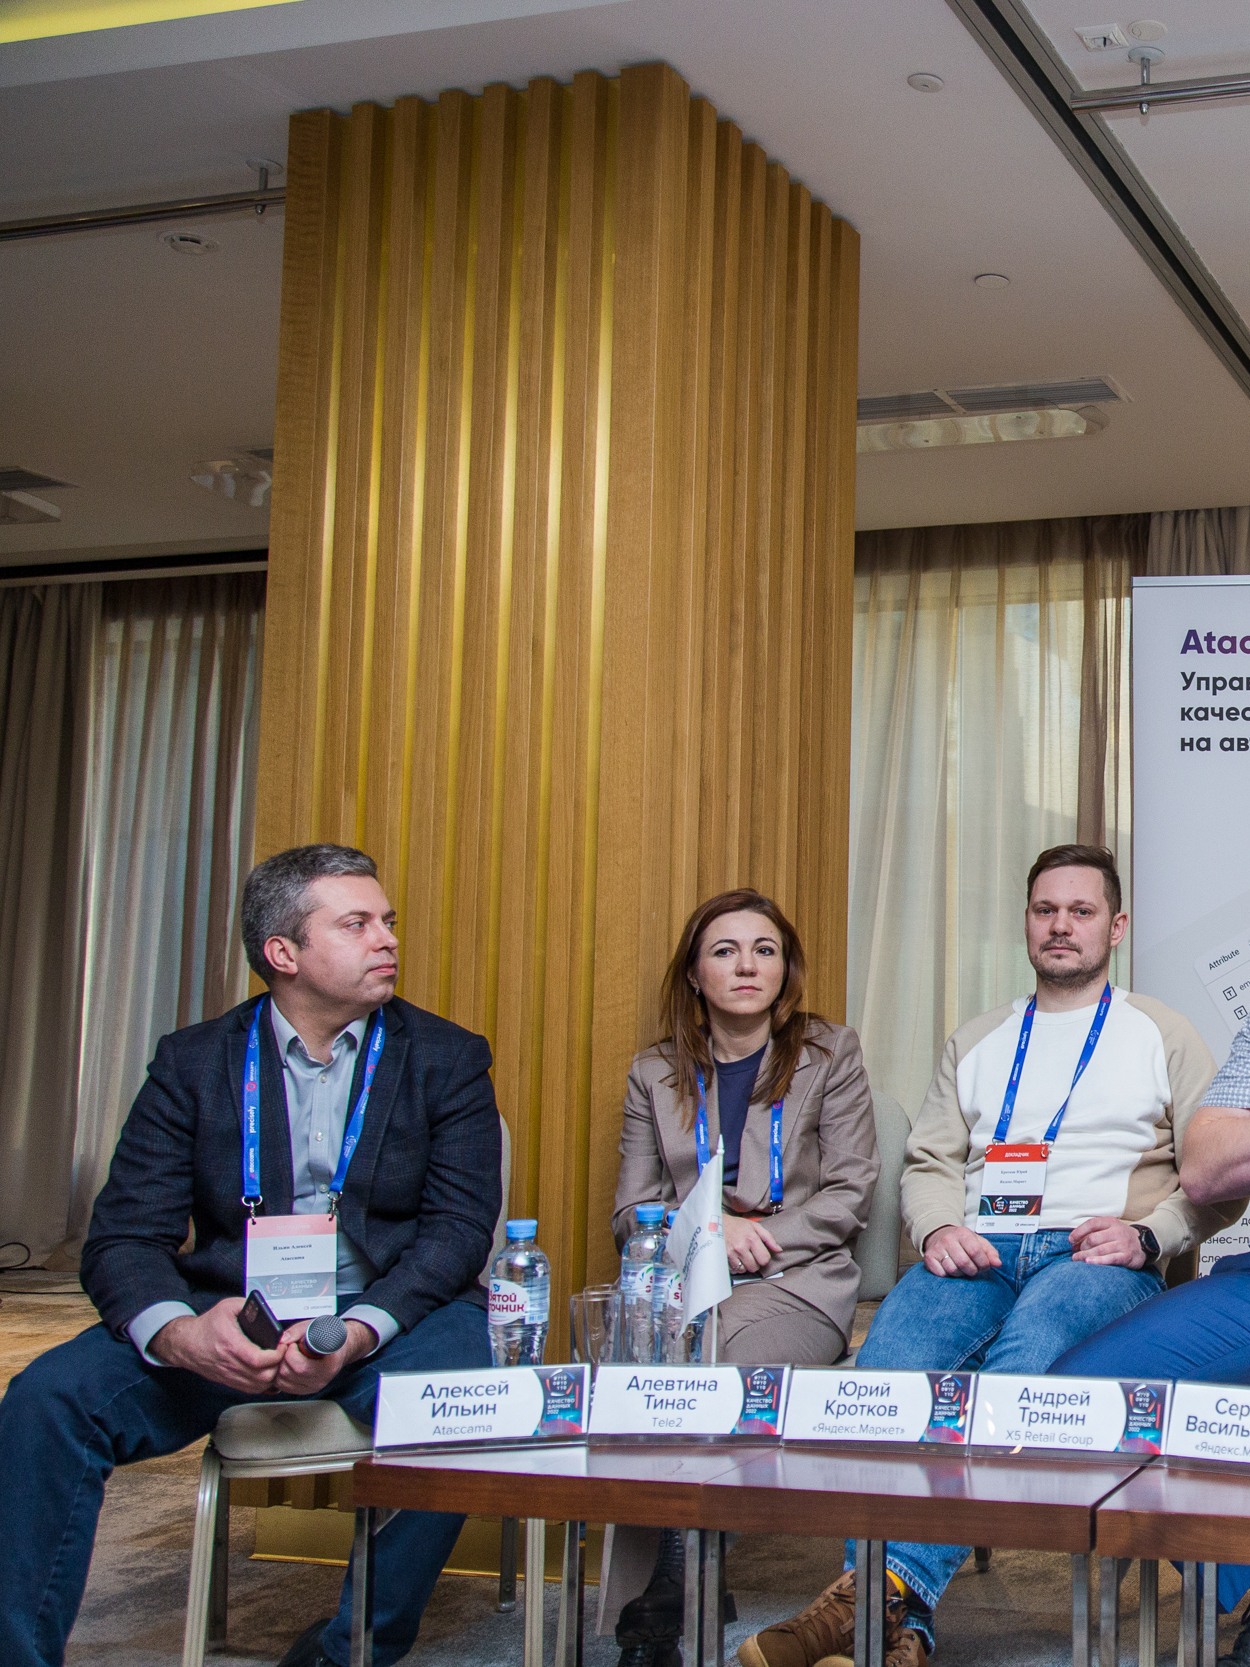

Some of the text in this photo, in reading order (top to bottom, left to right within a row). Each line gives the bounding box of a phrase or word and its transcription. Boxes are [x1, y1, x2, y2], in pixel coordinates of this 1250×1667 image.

[1180, 736, 1212, 752] на
[1209, 948, 1241, 971] Attribute
[421, 1380, 510, 1401] Алексей
[626, 1375, 718, 1393] Алевтина
[838, 1380, 891, 1399] Юрий
[644, 1394, 698, 1411] Тинас
[1018, 1387, 1091, 1408] Андрей
[431, 1402, 497, 1419] Ильин
[825, 1399, 898, 1418] Кротков
[1019, 1406, 1087, 1428] Трянин
[433, 1423, 493, 1437] Ataccama
[652, 1416, 683, 1428] Tele2
[812, 1422, 905, 1437] «Яндекс.Маркет»
[1006, 1429, 1094, 1447] X5 Retail Group
